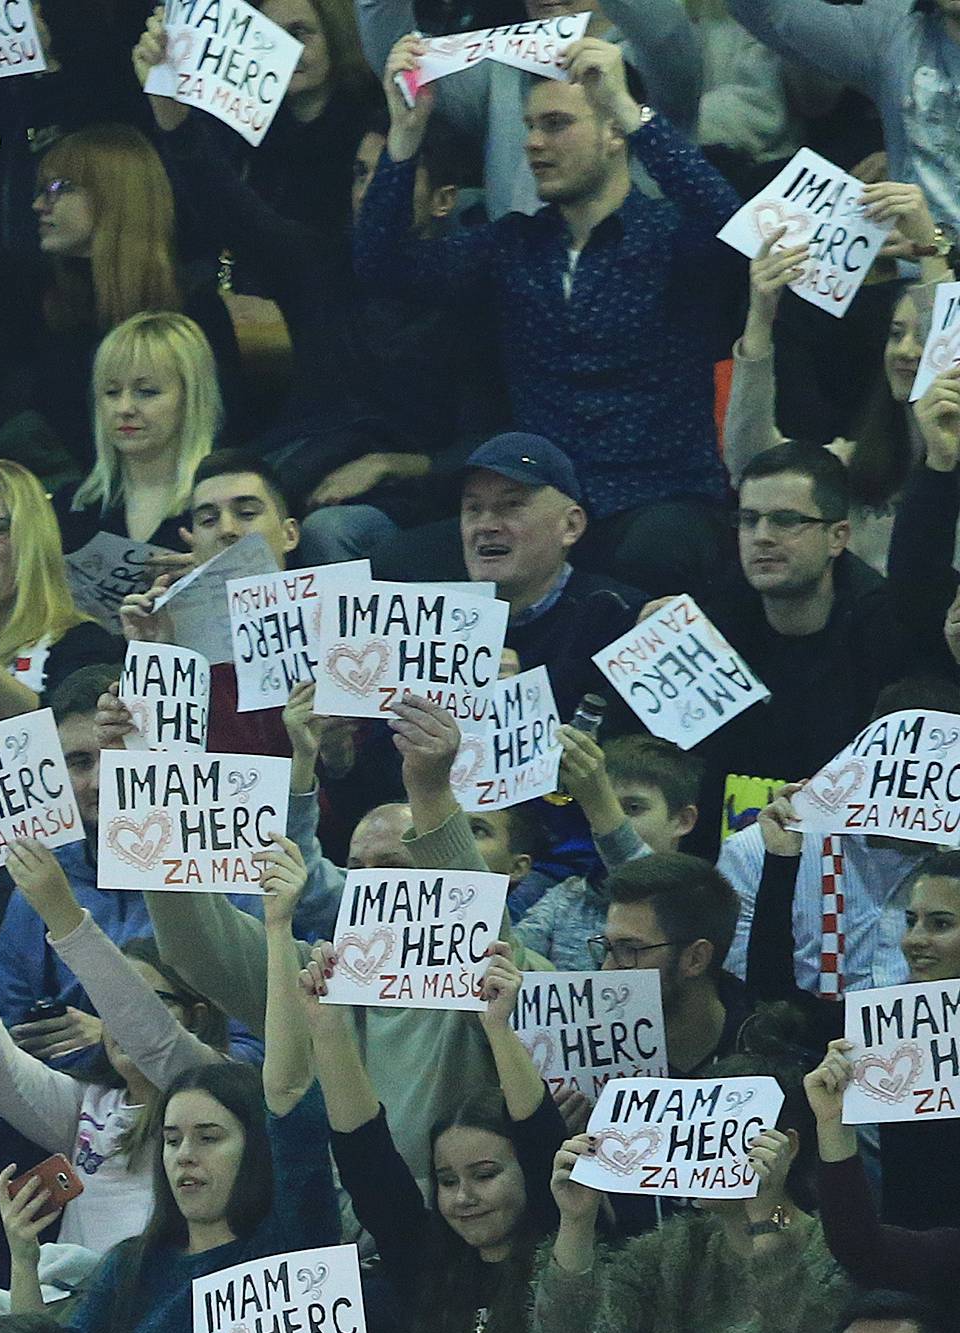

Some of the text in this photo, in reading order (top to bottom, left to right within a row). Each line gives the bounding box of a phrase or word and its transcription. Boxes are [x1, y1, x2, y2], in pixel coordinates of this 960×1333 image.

[198, 38, 279, 104] HERC
[464, 40, 495, 62] ZA
[176, 73, 205, 100] ZA
[285, 574, 318, 598] ZA
[236, 605, 306, 664] HERC
[338, 594, 444, 636] IMAM
[398, 640, 491, 688] HERC
[606, 603, 698, 681] ZA MAŠU
[643, 632, 718, 715] HERC
[494, 716, 560, 774] HERC
[115, 761, 221, 810] IMAM
[476, 780, 508, 804] ZA
[8, 808, 77, 843] MAŠU
[179, 805, 279, 852] HERC
[845, 803, 960, 833] ZA MAŠU
[162, 859, 203, 884] ZA
[350, 877, 444, 926] IMAM
[401, 921, 489, 968] HERC
[379, 971, 485, 999] ZA MAŠU
[514, 979, 596, 1031] IMAM
[560, 1018, 659, 1071] HERC
[549, 1077, 579, 1097] ZA
[610, 1085, 722, 1124] IMAM
[914, 1089, 955, 1113] ZA
[666, 1117, 769, 1163] HERC
[640, 1158, 758, 1190] ZA MAŠU
[203, 1261, 290, 1333] IMAM
